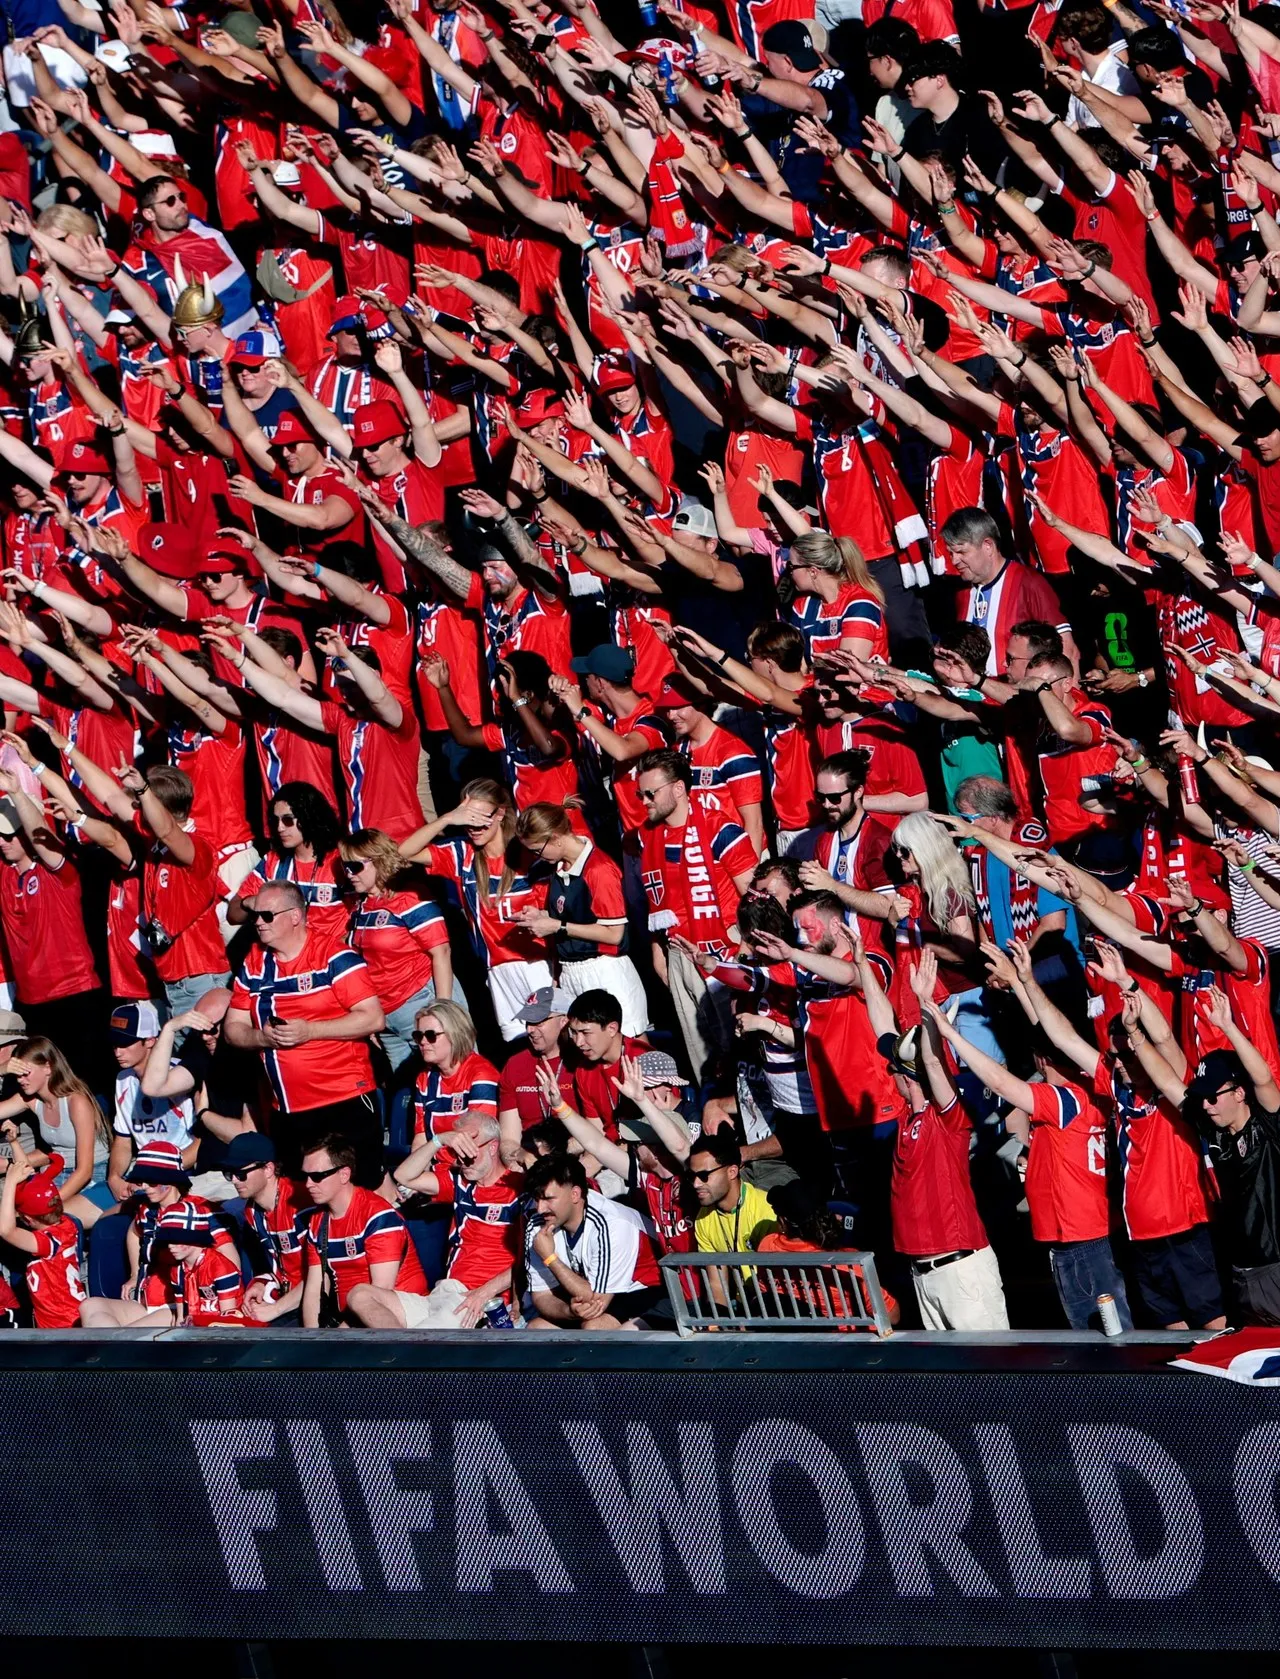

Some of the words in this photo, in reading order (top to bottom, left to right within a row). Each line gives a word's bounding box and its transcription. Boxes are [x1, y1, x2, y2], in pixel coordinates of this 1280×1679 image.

[497, 897, 513, 924] 11
[132, 1118, 168, 1134] USA
[189, 1419, 577, 1592] FIFA
[561, 1418, 1203, 1599] WORLD
